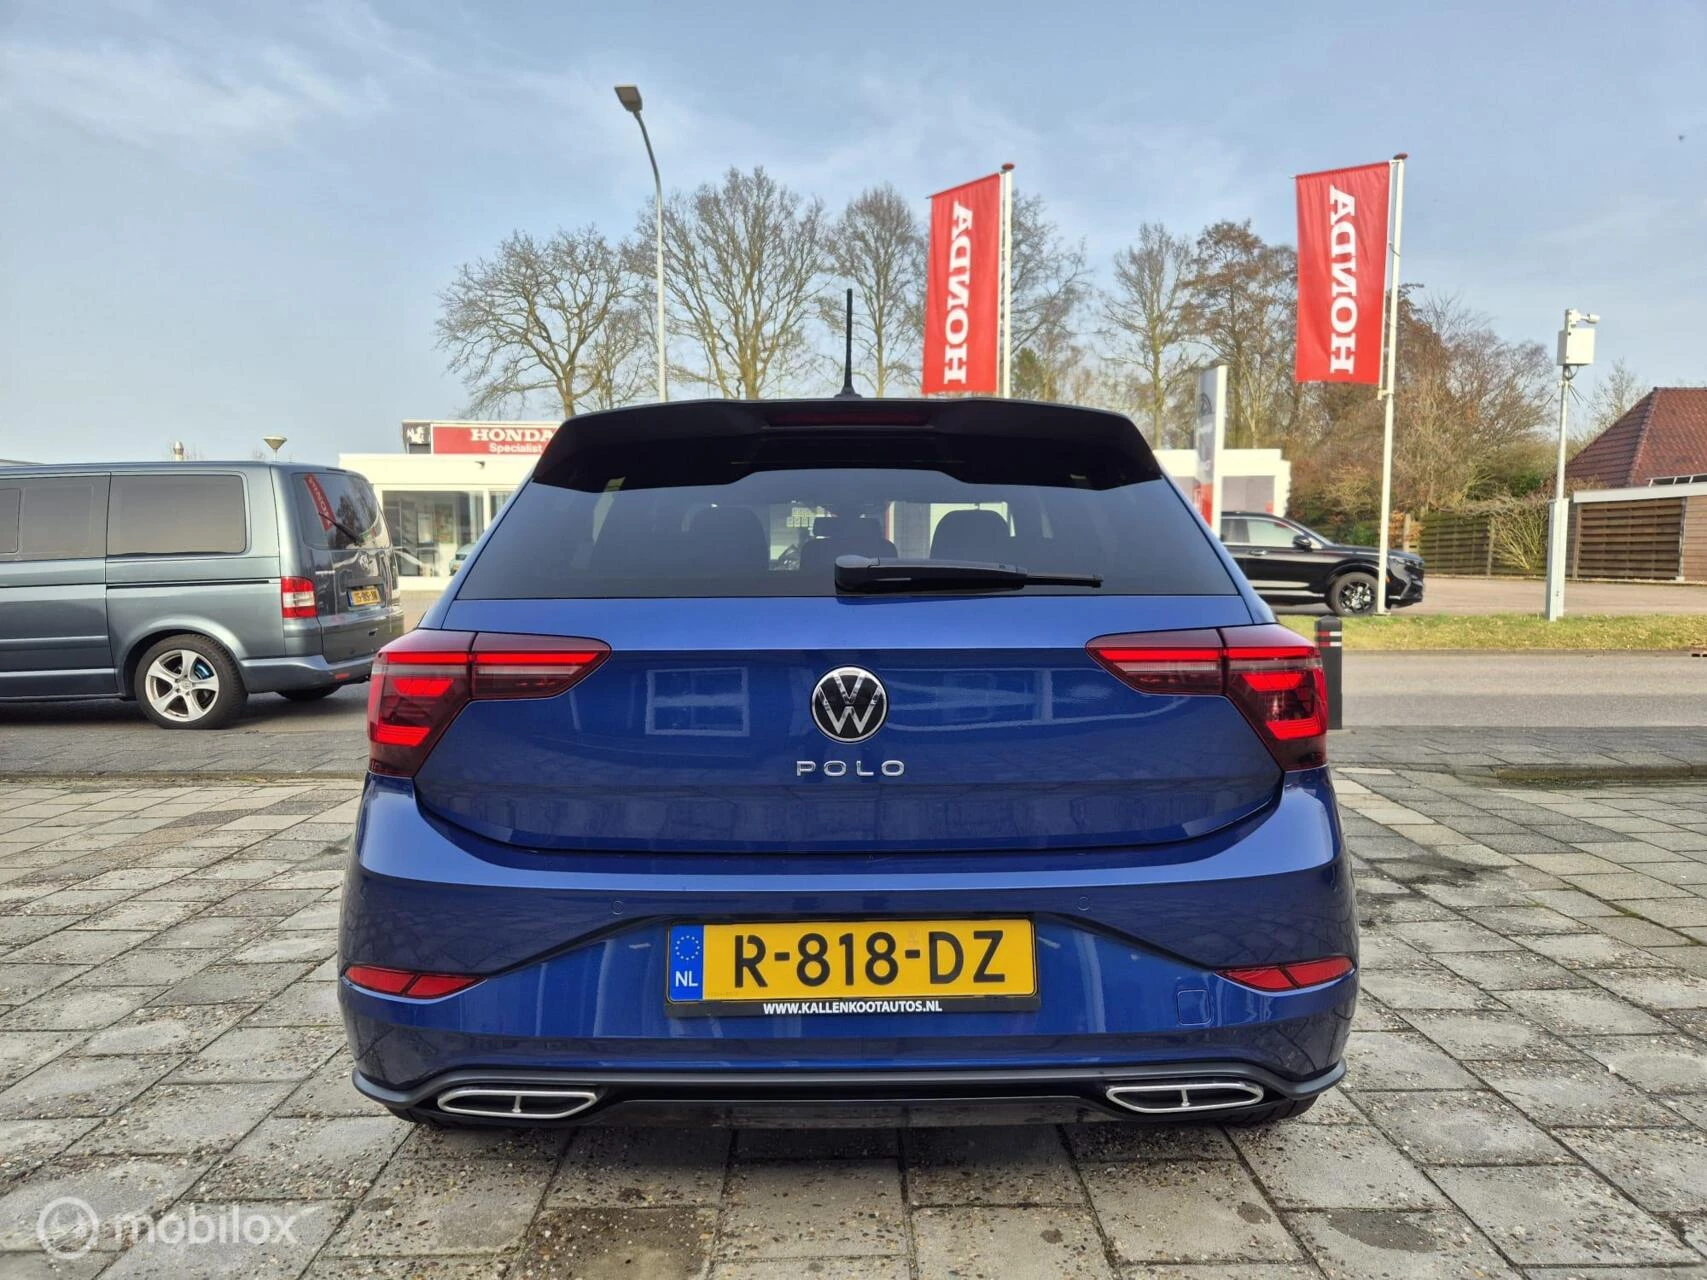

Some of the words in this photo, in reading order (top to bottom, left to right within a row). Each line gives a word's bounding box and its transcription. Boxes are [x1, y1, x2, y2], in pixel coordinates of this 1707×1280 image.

[471, 428, 554, 442] HONDA
[488, 442, 543, 454] Specialist
[796, 760, 905, 777] POLO
[734, 930, 1006, 988] R-818-DZ
[674, 970, 699, 988] NL
[763, 1000, 943, 1015] WWW.KALLENKOOTAUTOS.NL
